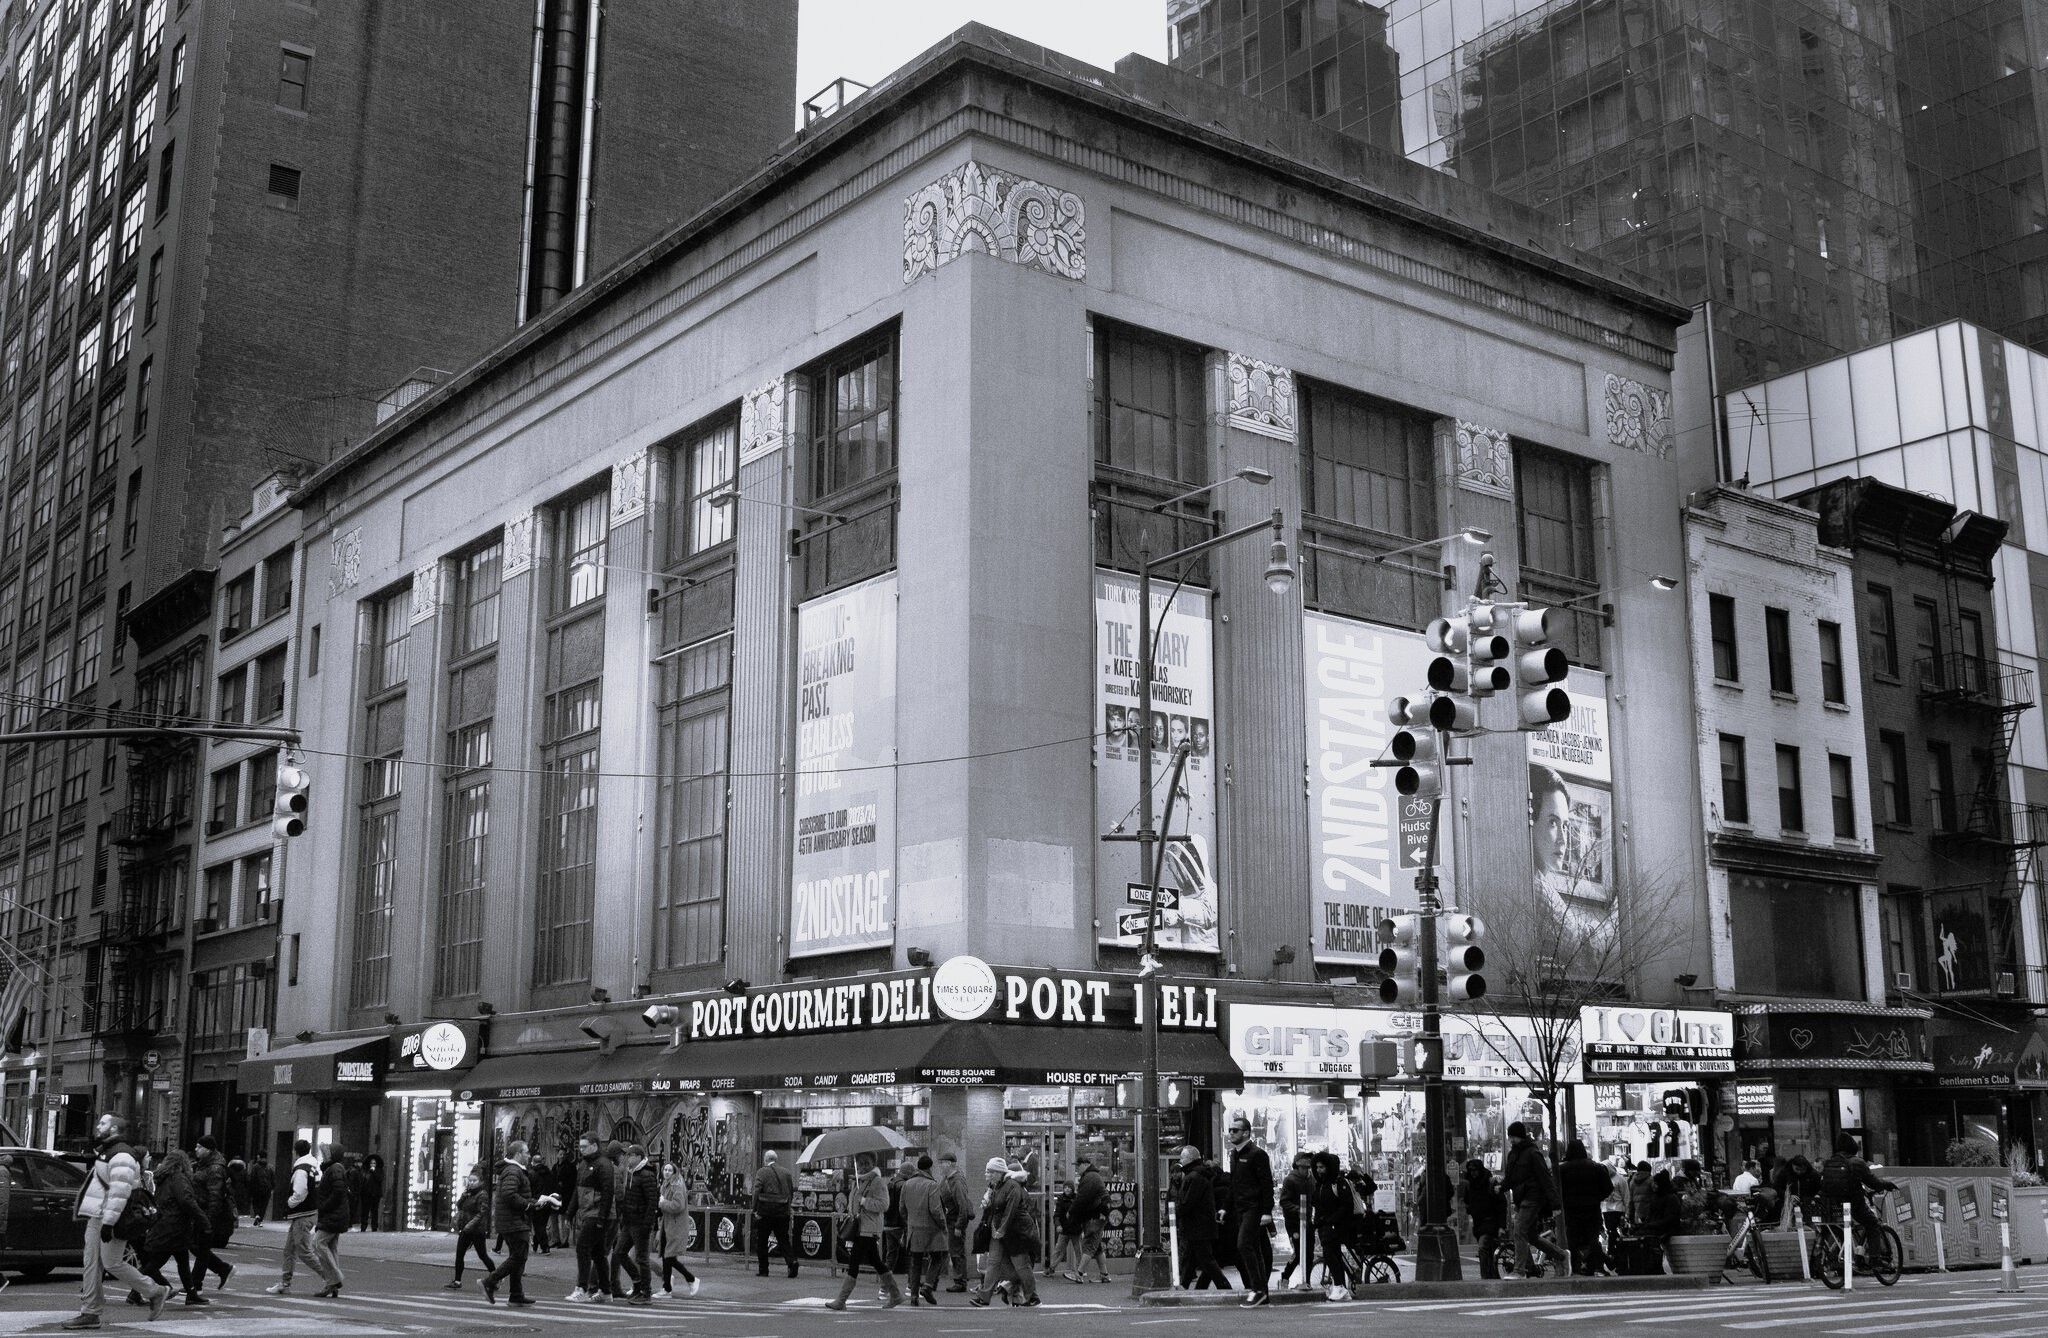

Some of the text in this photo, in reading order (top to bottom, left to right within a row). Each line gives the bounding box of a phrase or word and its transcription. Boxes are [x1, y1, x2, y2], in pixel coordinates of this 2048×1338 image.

[1104, 583, 1123, 603] TONY
[1125, 588, 1141, 606] KISE
[1105, 620, 1190, 668] THE IARY
[803, 636, 855, 686] BREAKING
[1113, 658, 1133, 679] KATE
[1135, 661, 1168, 684] DLAS
[1151, 681, 1193, 706] WHORISKEY
[801, 681, 830, 722] PAST.
[801, 711, 854, 760] FEARLESS
[1549, 744, 1560, 760] LILA
[1316, 623, 1391, 898] 2NDSTAGE
[799, 803, 877, 836] SUBSCRIBE TO OUR 2023/24
[1400, 820, 1431, 832] Hudso
[813, 828, 851, 853] ANNIVERSARY
[851, 823, 877, 846] SEASON
[1407, 833, 1429, 845] Rive
[1134, 889, 1150, 900] ONE
[795, 869, 890, 943] 2NDSTAGE
[1323, 901, 1341, 926] THE
[1343, 903, 1371, 929] HOME
[1372, 906, 1384, 929] OF
[1125, 919, 1139, 930] ONE
[1324, 927, 1373, 954] AMERICAN
[936, 984, 994, 994] TIMES SQUARE
[1005, 975, 1110, 1023] PORT
[691, 976, 931, 1038] PORT GOURMET DELI
[1594, 1008, 1612, 1042] I
[1244, 1025, 1350, 1058] GIFTS
[1398, 1032, 1576, 1064] UVENIS
[430, 1053, 458, 1066] Shop
[1597, 1060, 1613, 1071] NYPD
[1633, 1061, 1653, 1071] MONEY
[1656, 1061, 1679, 1071] CHANGE
[1699, 1062, 1730, 1071] SOUVENIRS
[337, 1062, 374, 1077] 2NDSTAGE
[1263, 1062, 1284, 1072] TOYS
[1319, 1063, 1353, 1073] LUGGAGE
[1447, 1065, 1466, 1075] NYPD
[679, 1079, 701, 1089] WRAPS
[711, 1078, 735, 1089] COFFEE
[784, 1076, 803, 1087] SODA
[813, 1074, 838, 1086] CANDY
[851, 1072, 896, 1085] CIGARETTES
[1046, 1072, 1082, 1084] HOUSE
[1083, 1073, 1097, 1084] OF
[1939, 1075, 1990, 1086] Gentlemen's
[1990, 1074, 2010, 1084] Club
[579, 1084, 589, 1094] HOT
[595, 1083, 608, 1093] COLD
[608, 1081, 643, 1092] SANDWICES
[651, 1080, 671, 1090] SALAD
[1595, 1085, 1621, 1098] VAPE
[1736, 1085, 1774, 1094] MONEY
[499, 1088, 511, 1097] JUICE
[515, 1087, 541, 1096] SMOOTHIES
[1595, 1097, 1623, 1110] SHOP
[1737, 1095, 1775, 1104] CHANGE
[1737, 1107, 1776, 1115] SOUVENIRS
[1105, 1182, 1136, 1192] AKFAST
